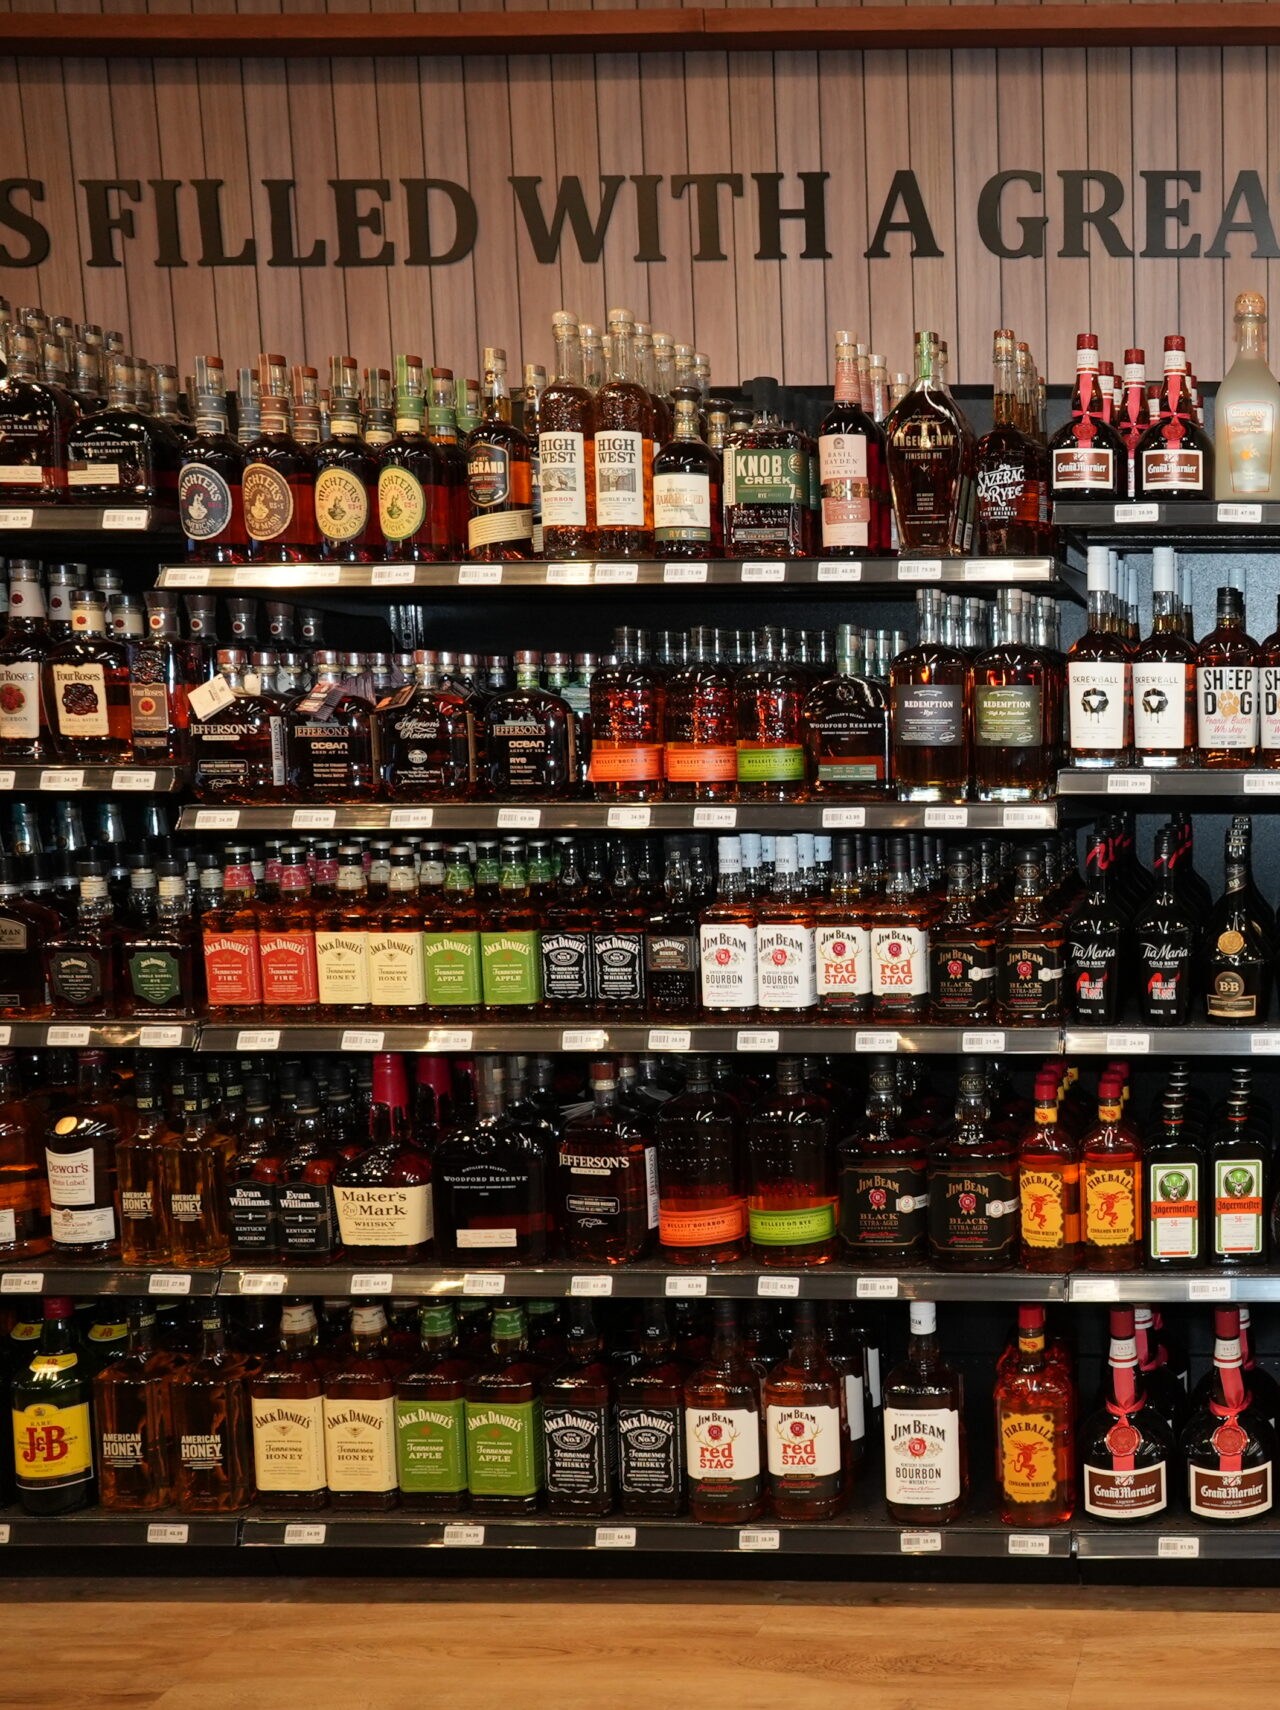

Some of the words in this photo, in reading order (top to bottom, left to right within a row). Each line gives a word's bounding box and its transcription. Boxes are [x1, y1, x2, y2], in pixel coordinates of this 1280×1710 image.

[0, 178, 50, 268] S
[79, 179, 478, 268] FILLED
[508, 171, 833, 264] WITH
[863, 169, 945, 258] A
[540, 438, 576, 452] HIGH
[598, 438, 636, 452] HIGH
[541, 452, 576, 464] WEST
[598, 452, 636, 464] WEST
[824, 457, 858, 465] HAYDEN
[468, 461, 505, 475] LEGRAND
[736, 454, 782, 476] KNOB
[744, 476, 791, 485] CREEK
[977, 466, 1025, 496] SAZERAC
[789, 484, 796, 499] 7
[668, 530, 687, 538] RYE
[1072, 674, 1119, 685] SKREWBALL
[1134, 674, 1179, 685] SKREWBALL
[1203, 668, 1253, 692] SHEEP
[904, 700, 954, 708] REDEMPTION
[983, 700, 1031, 708] REDEMPTION
[190, 723, 258, 736] JEFFERSON'S
[493, 725, 546, 736] JEFFERSON'S
[311, 741, 348, 750] OCEAN
[509, 740, 544, 748] OCEAN
[1070, 942, 1085, 958] Tia
[1082, 946, 1115, 958] Maria
[824, 961, 856, 974] red
[705, 975, 743, 985] BOURBON
[762, 976, 799, 985] BOURBON
[824, 974, 857, 985] STAG
[880, 974, 913, 985] STAG
[559, 1151, 630, 1169] JEFFERSON'S
[48, 1161, 90, 1175] Dewar's
[444, 1175, 487, 1183] WOODFORD
[489, 1175, 528, 1183] RESERVE
[1020, 1176, 1061, 1192] FIREBALL
[122, 1191, 152, 1199] AMERICAN
[236, 1188, 261, 1198] Evan
[286, 1190, 311, 1200] Evan
[341, 1190, 407, 1203] Maker's
[122, 1198, 152, 1211] HONEY
[358, 1203, 408, 1216] Mark
[255, 1412, 276, 1429] JACK
[277, 1408, 311, 1429] DANIEL'S
[891, 1424, 912, 1442] JIM
[913, 1420, 946, 1442] BEAM
[1005, 1422, 1051, 1439] FIREBALL
[103, 1433, 141, 1443] AMERICAN
[181, 1435, 220, 1444] AMERICAN
[103, 1442, 143, 1457] HONEY
[700, 1443, 733, 1459] red
[781, 1440, 815, 1455] red
[337, 1454, 375, 1462] HONEY
[409, 1451, 442, 1460] APPLE
[781, 1454, 816, 1466] STAG
[700, 1458, 734, 1470] STAG
[895, 1467, 942, 1480] BOURBON
